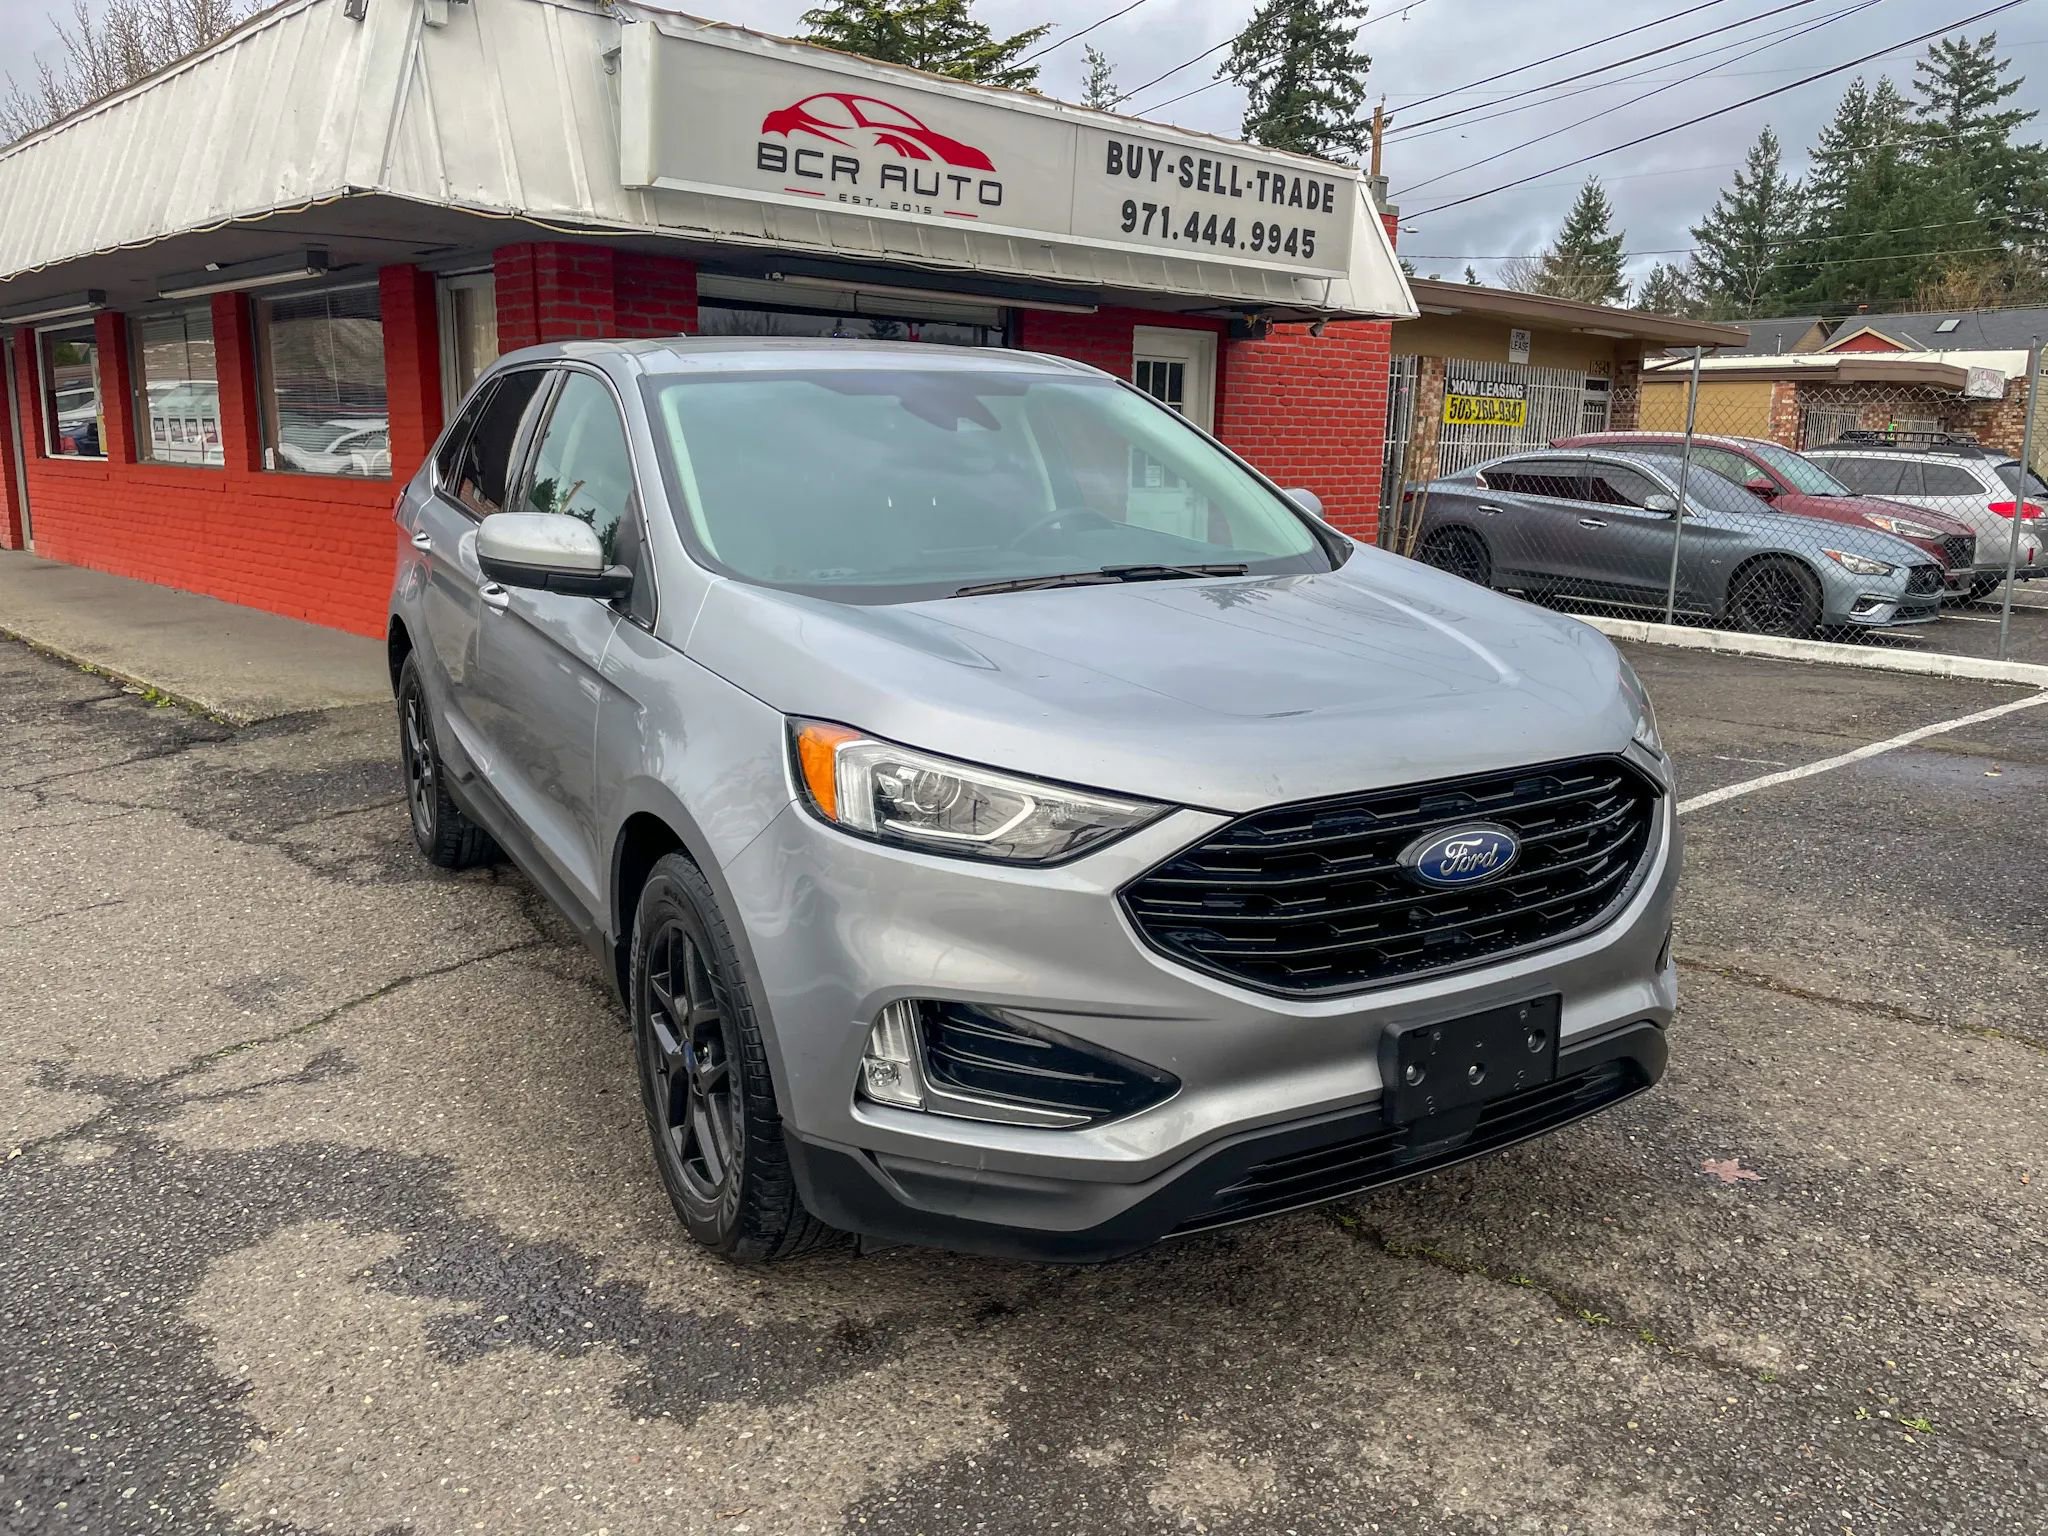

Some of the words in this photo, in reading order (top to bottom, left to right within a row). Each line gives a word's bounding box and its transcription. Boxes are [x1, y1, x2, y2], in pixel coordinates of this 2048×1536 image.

[757, 141, 860, 185] BCR
[880, 163, 1003, 207] AUTO
[838, 193, 879, 208] EST.
[890, 201, 933, 215] 2015
[1121, 199, 1316, 259] 971.444.9945
[1510, 340, 1530, 352] LEASE
[1451, 379, 1478, 395] NOW
[1480, 382, 1524, 399] LEASING
[1440, 838, 1499, 877] Ford
